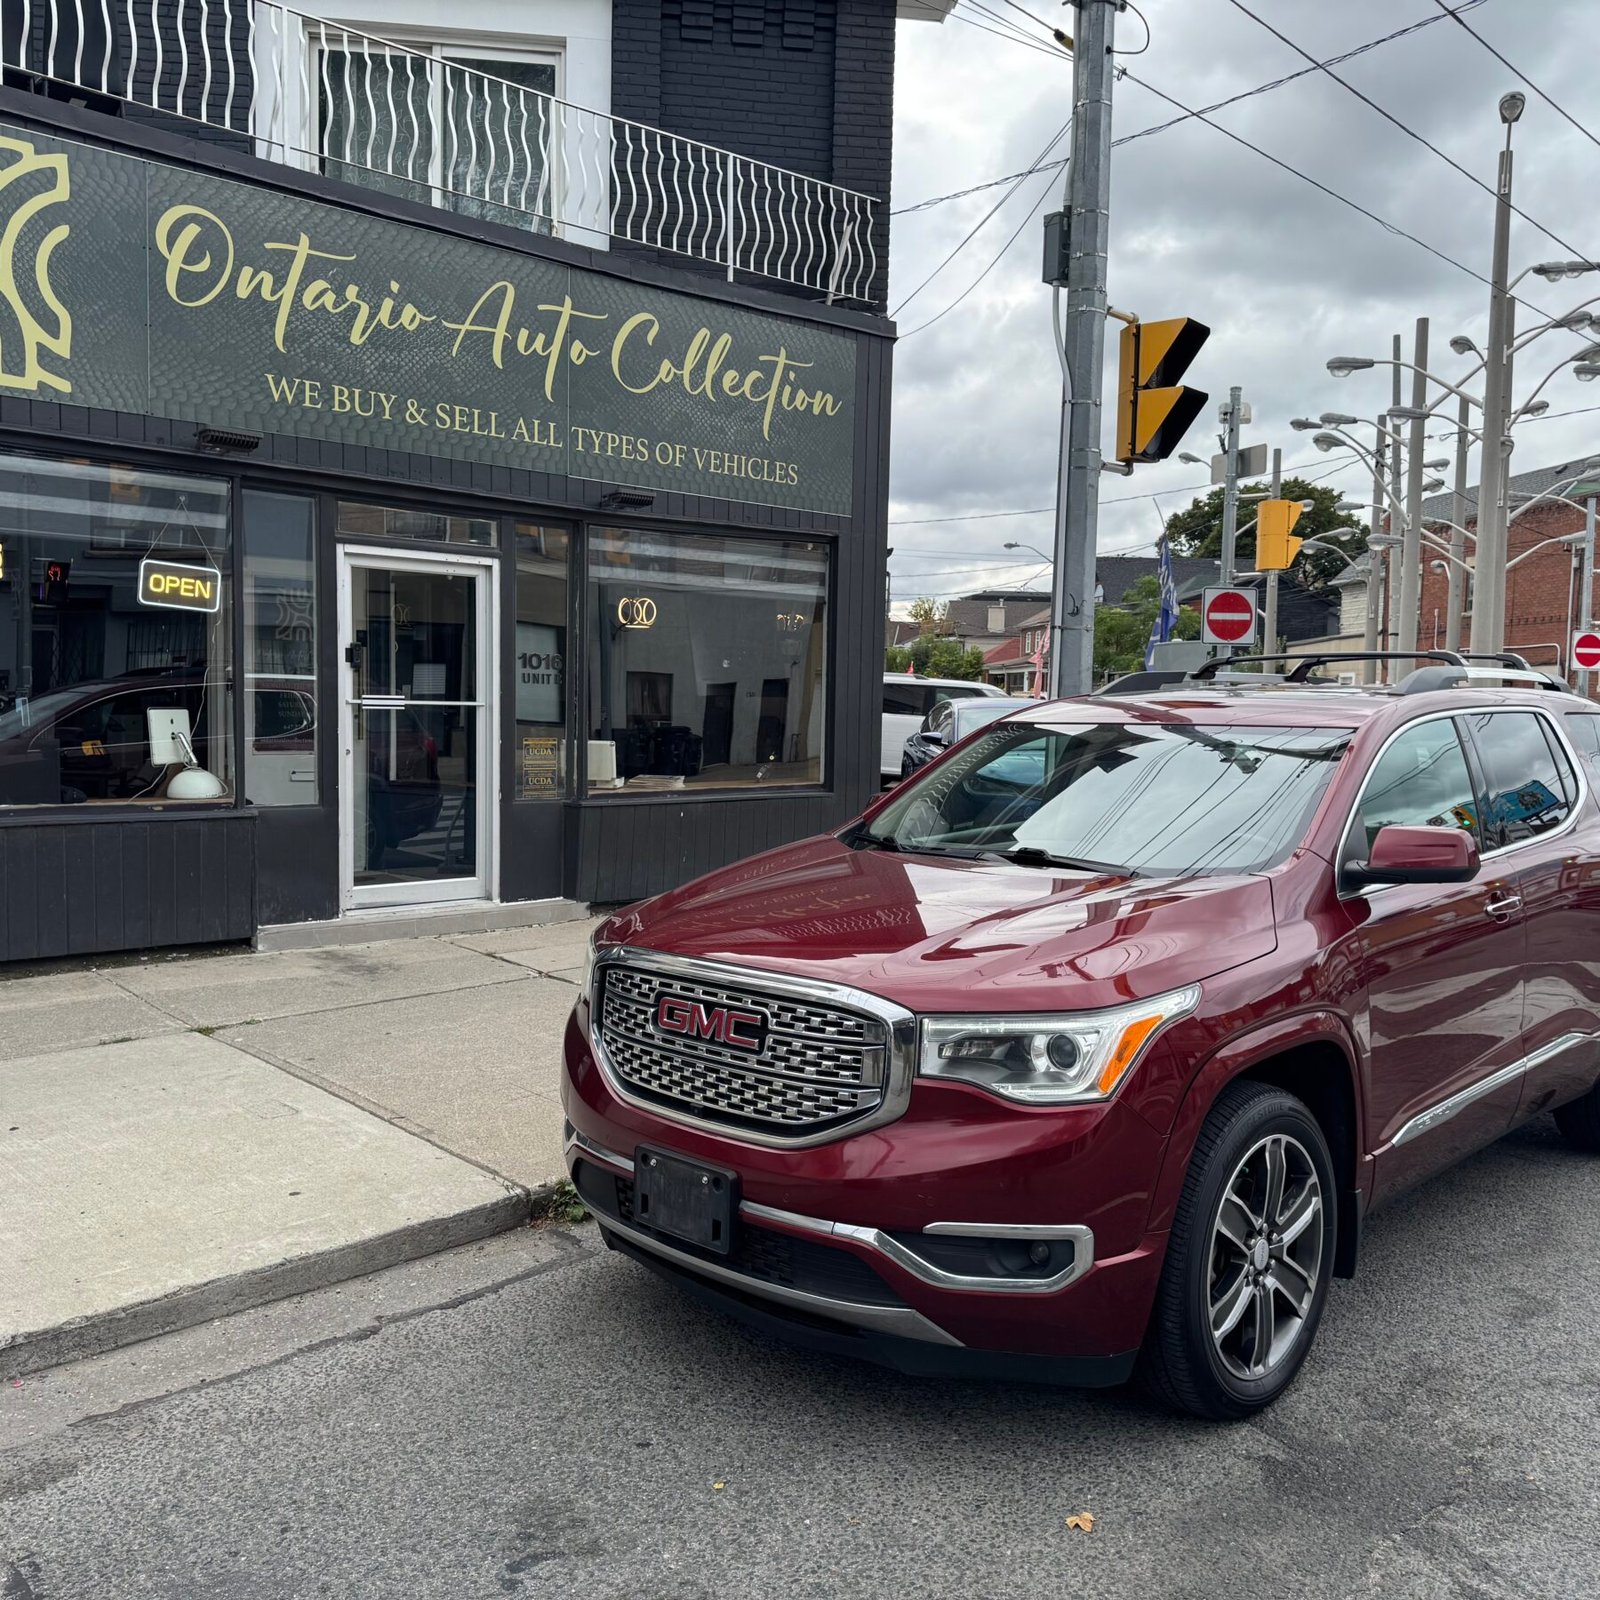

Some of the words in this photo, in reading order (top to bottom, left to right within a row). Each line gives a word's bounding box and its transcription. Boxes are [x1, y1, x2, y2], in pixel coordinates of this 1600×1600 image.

[155, 204, 437, 353] Ontario
[441, 280, 608, 402] Auto
[611, 312, 842, 442] Collection
[264, 373, 323, 408] WE
[331, 384, 398, 420] BUY
[405, 398, 428, 426] &
[435, 402, 505, 438] SELL
[511, 416, 563, 447] ALL
[571, 426, 649, 462] TYPES
[655, 441, 688, 467] OF
[692, 447, 798, 485] VEHICLES
[149, 573, 211, 599] OPEN
[517, 652, 562, 670] 1016
[522, 672, 552, 685] UNIT
[529, 747, 552, 756] UCDA
[528, 777, 552, 785] UCDA
[658, 996, 762, 1051] GMC
